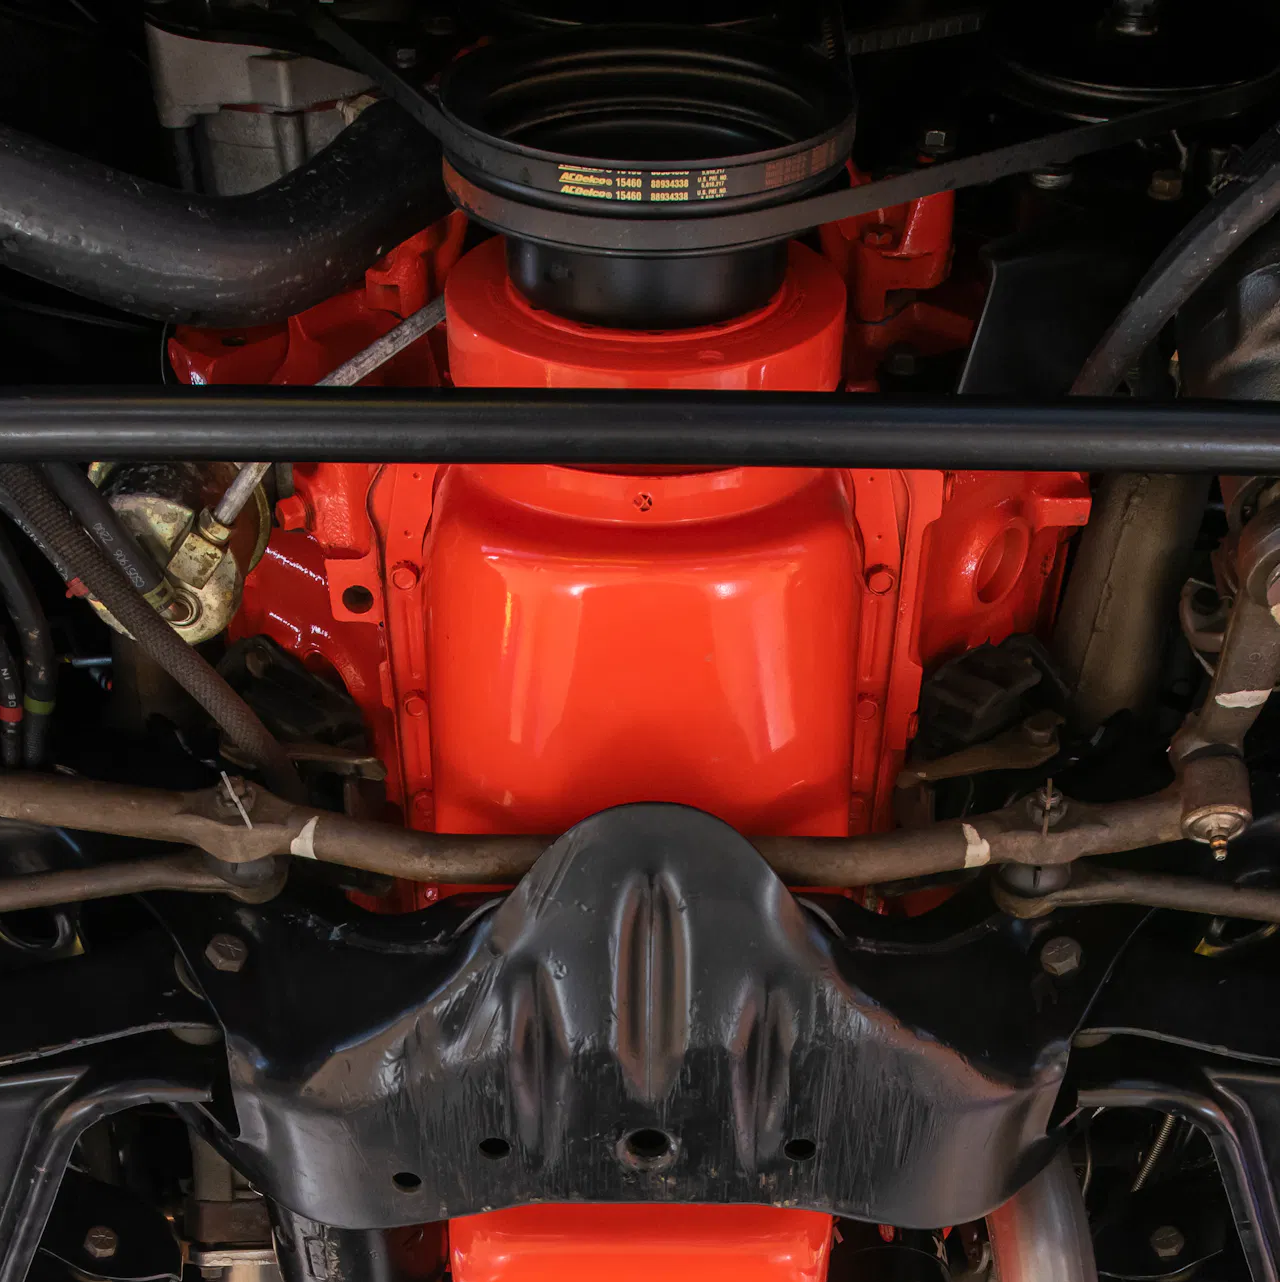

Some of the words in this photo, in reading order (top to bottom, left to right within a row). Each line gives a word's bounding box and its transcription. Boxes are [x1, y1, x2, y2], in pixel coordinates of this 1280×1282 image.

[615, 178, 642, 188] 15460
[650, 179, 689, 189] 88934338
[615, 191, 642, 201] 15460
[650, 192, 689, 201] 88934338
